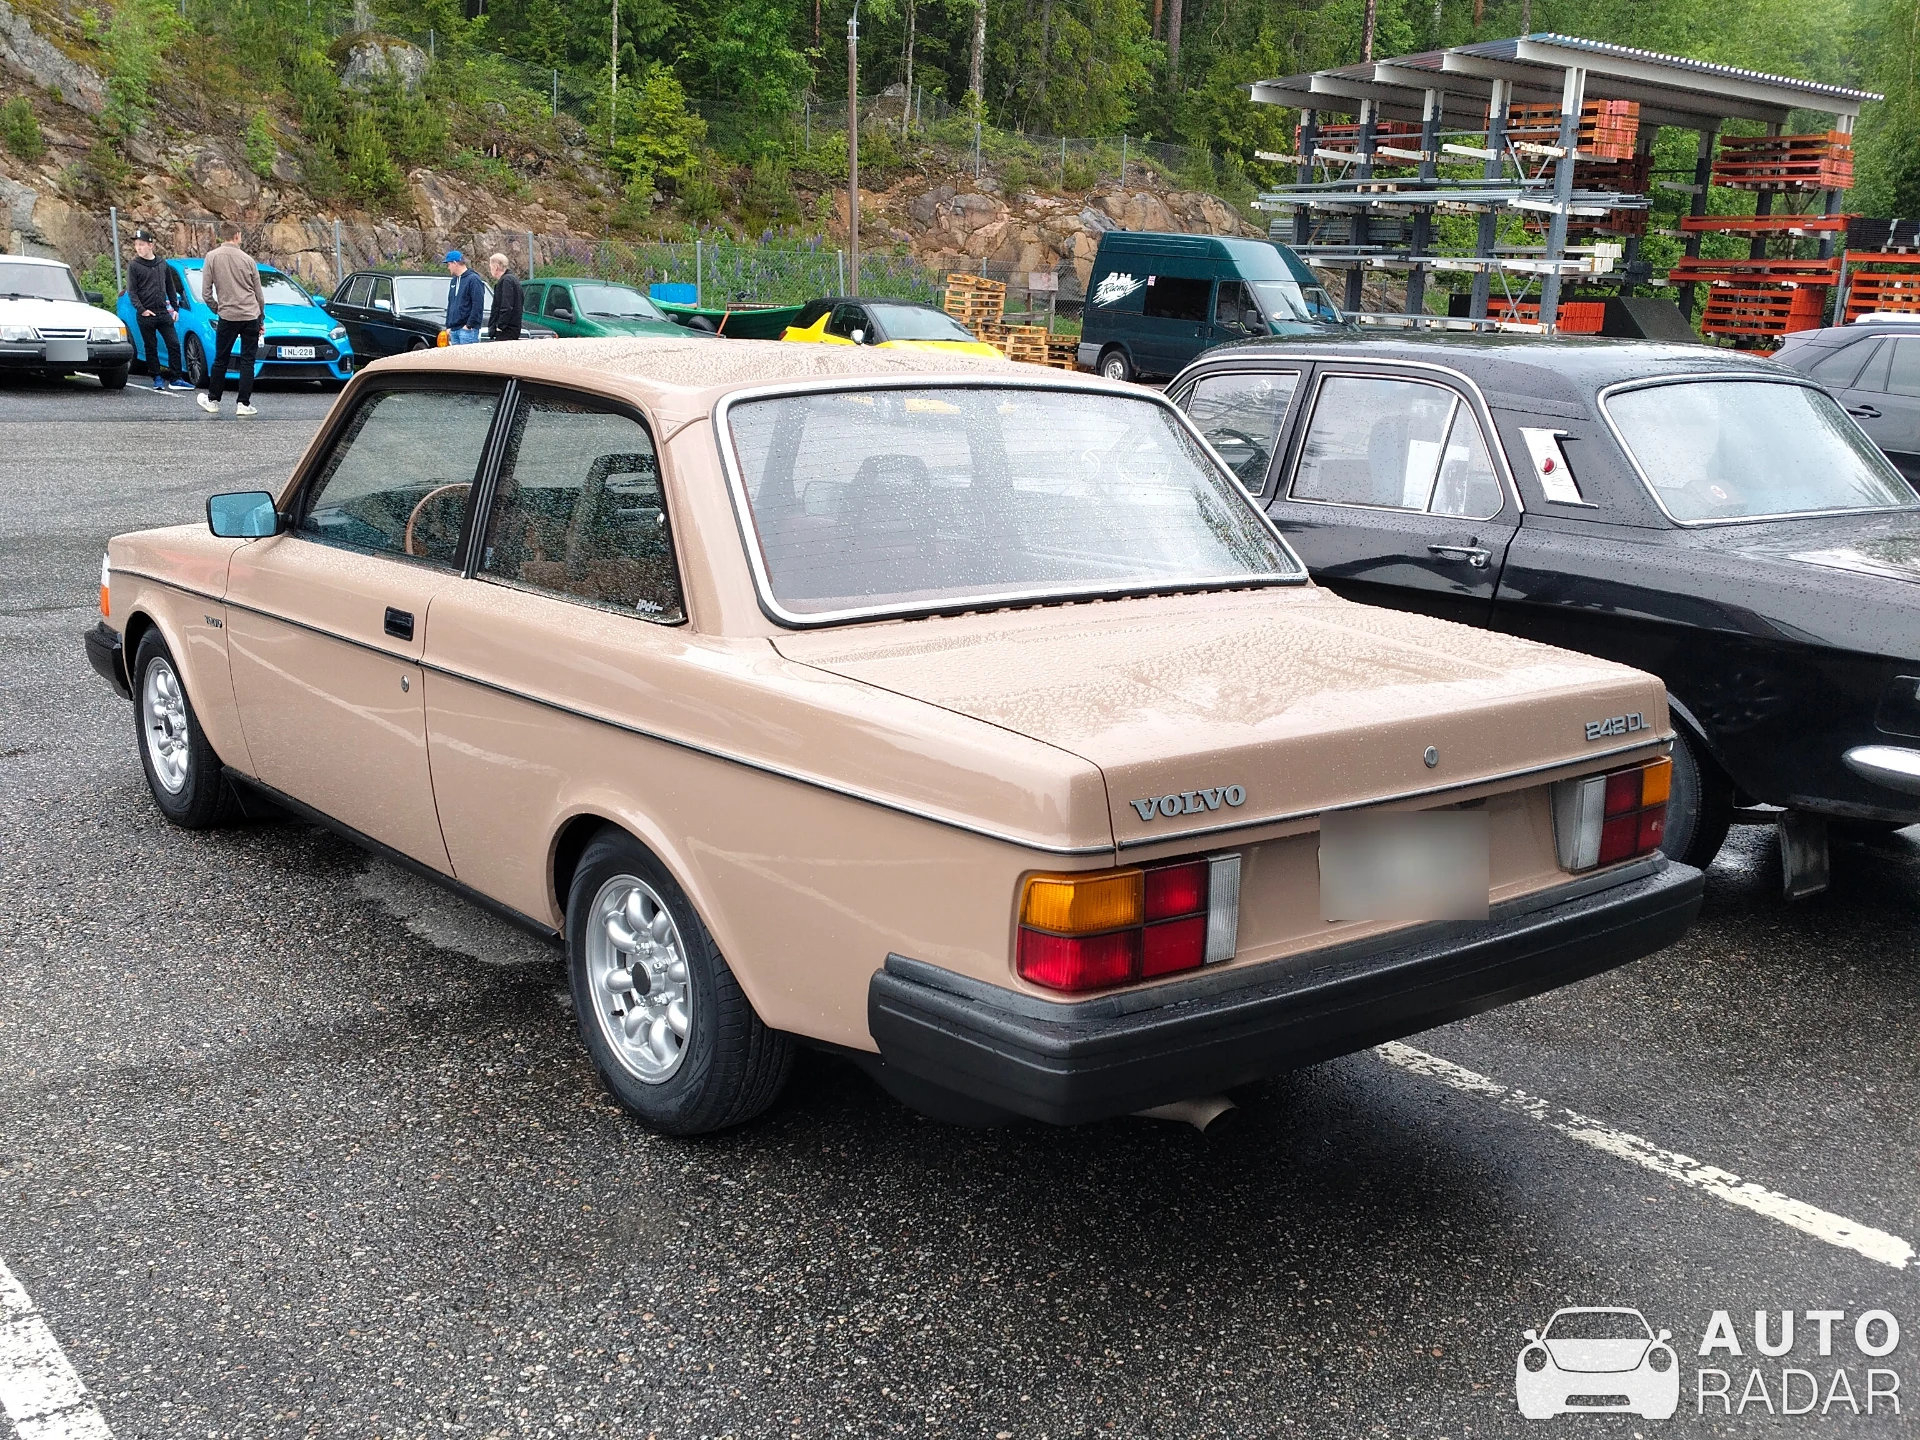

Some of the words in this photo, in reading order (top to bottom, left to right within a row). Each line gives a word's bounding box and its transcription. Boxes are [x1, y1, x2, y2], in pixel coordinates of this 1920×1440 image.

[1585, 715, 1627, 741] 242
[1626, 711, 1652, 732] DL
[1129, 784, 1247, 821] VOLVO
